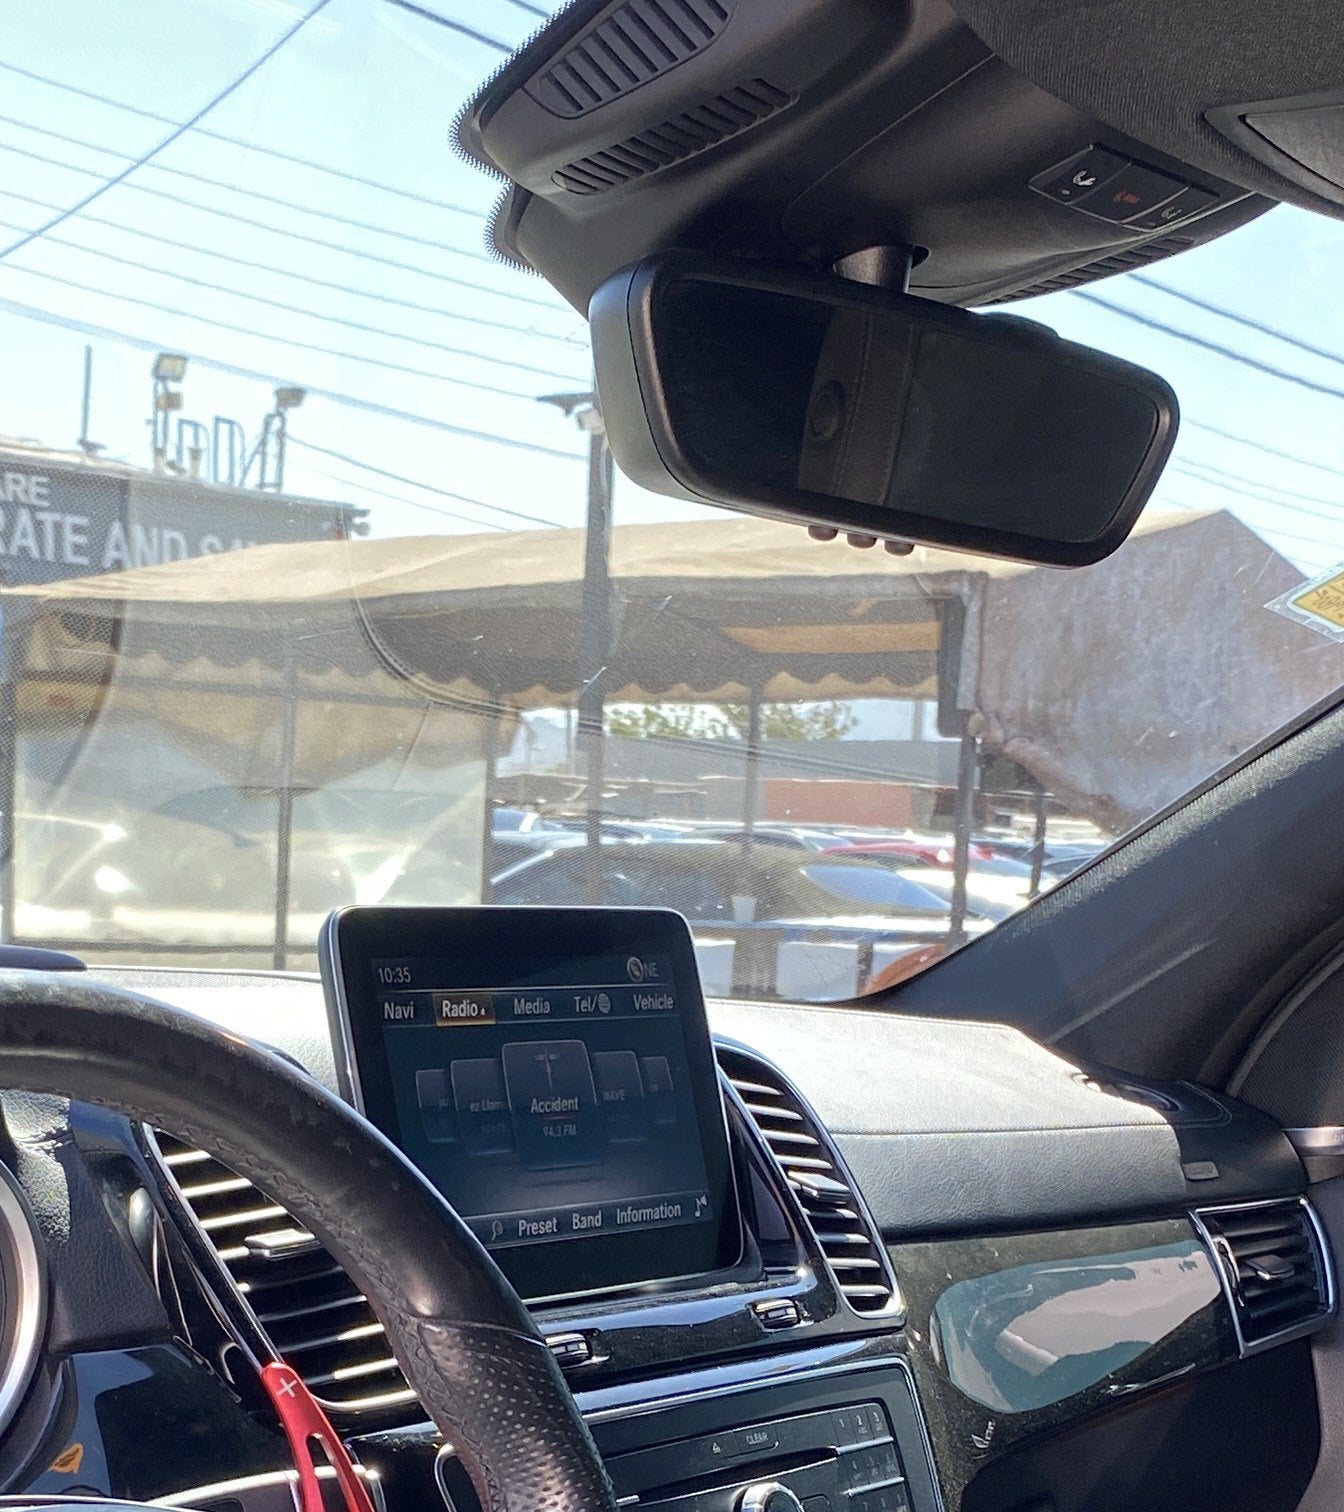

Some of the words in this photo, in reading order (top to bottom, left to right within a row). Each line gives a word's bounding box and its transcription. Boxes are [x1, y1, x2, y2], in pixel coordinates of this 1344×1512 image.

[103, 520, 188, 570] AND
[378, 966, 411, 984] 10:35
[644, 963, 660, 978] NE
[384, 1001, 414, 1020] Navi
[442, 999, 478, 1019] Radio
[514, 997, 551, 1016] Media
[633, 993, 674, 1012] Vehicle
[530, 1097, 579, 1115] Accident
[518, 1218, 558, 1237] Preset
[572, 1212, 602, 1231] Band
[616, 1203, 681, 1226] Information
[746, 1432, 769, 1445] CLEAR
